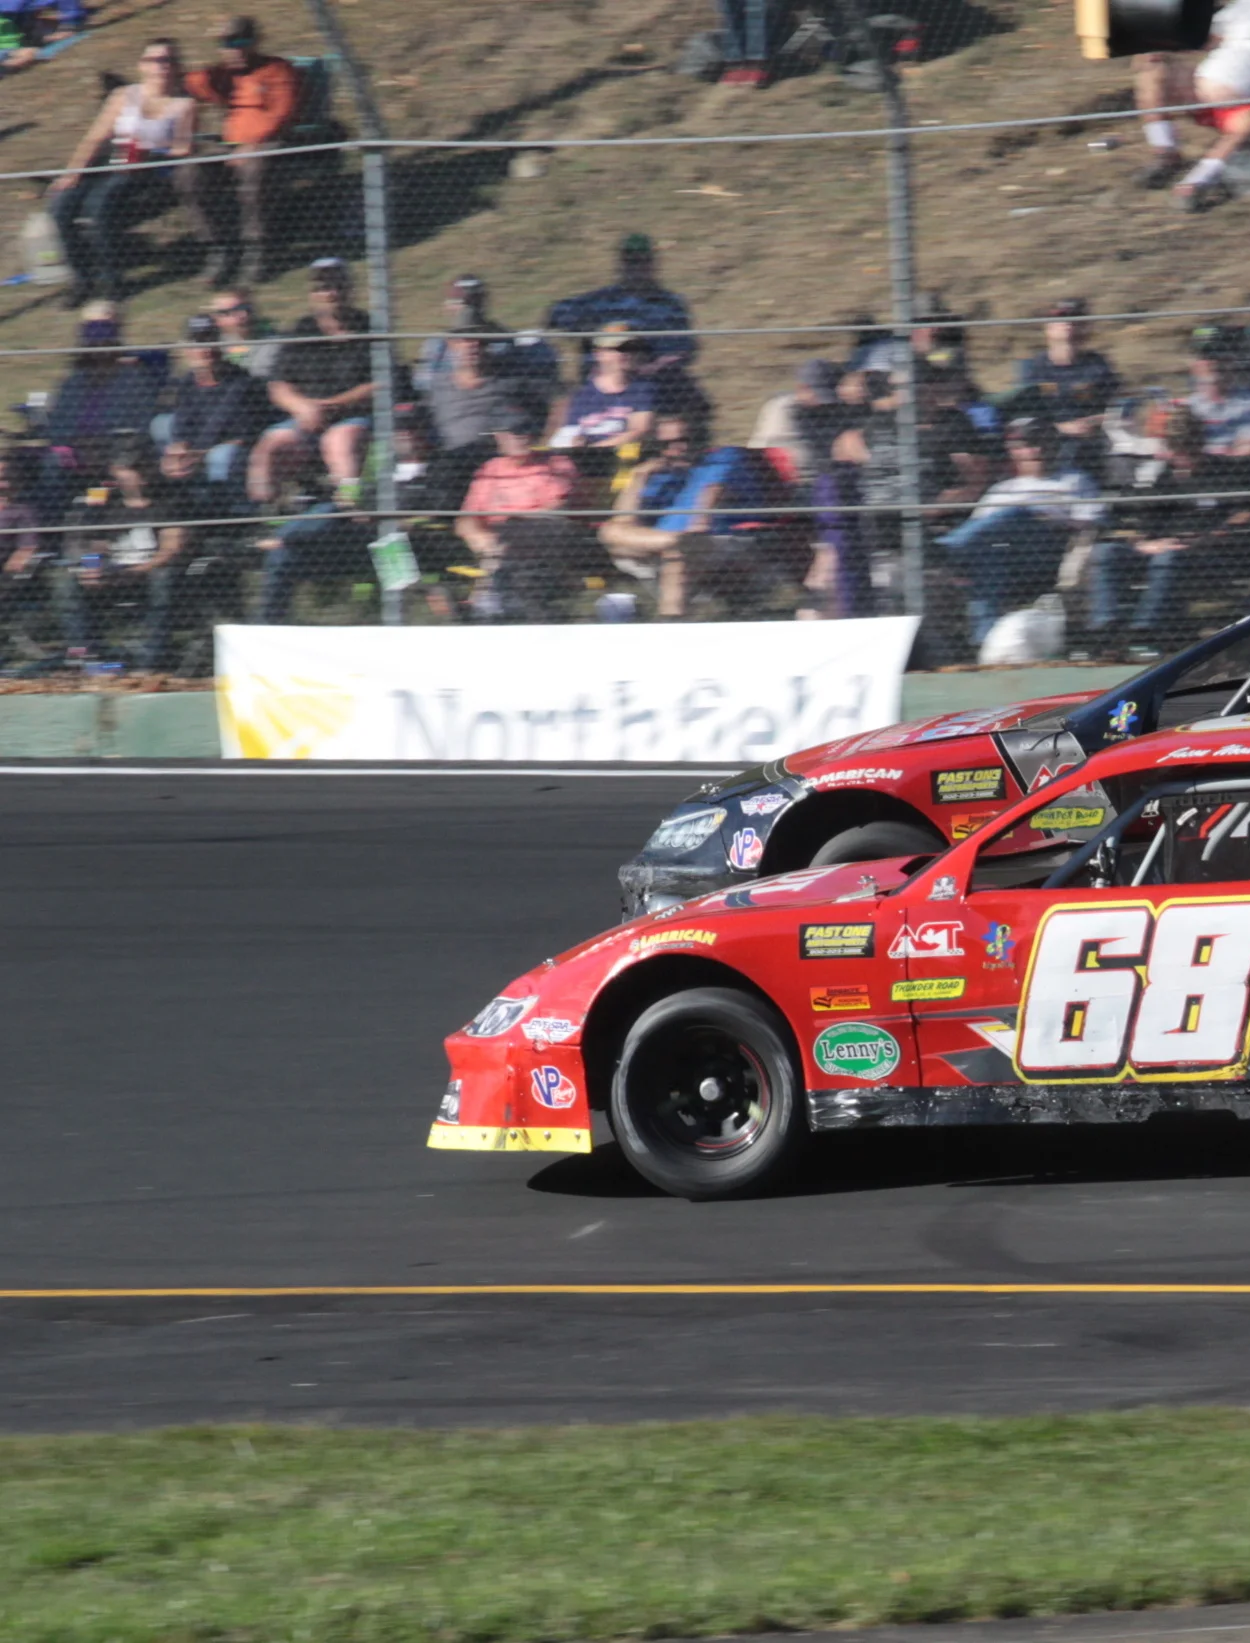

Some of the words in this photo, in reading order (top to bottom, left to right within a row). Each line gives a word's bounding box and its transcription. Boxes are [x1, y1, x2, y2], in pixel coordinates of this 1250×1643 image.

[388, 676, 872, 761] Northfield
[936, 770, 974, 785] FAST
[732, 827, 756, 867] VP
[804, 924, 841, 938] FAST
[842, 924, 873, 938] ONE
[894, 980, 934, 993] THUNDER
[935, 979, 961, 991] ROAD
[820, 1038, 895, 1063] Lenny's
[530, 1065, 561, 1106] VP
